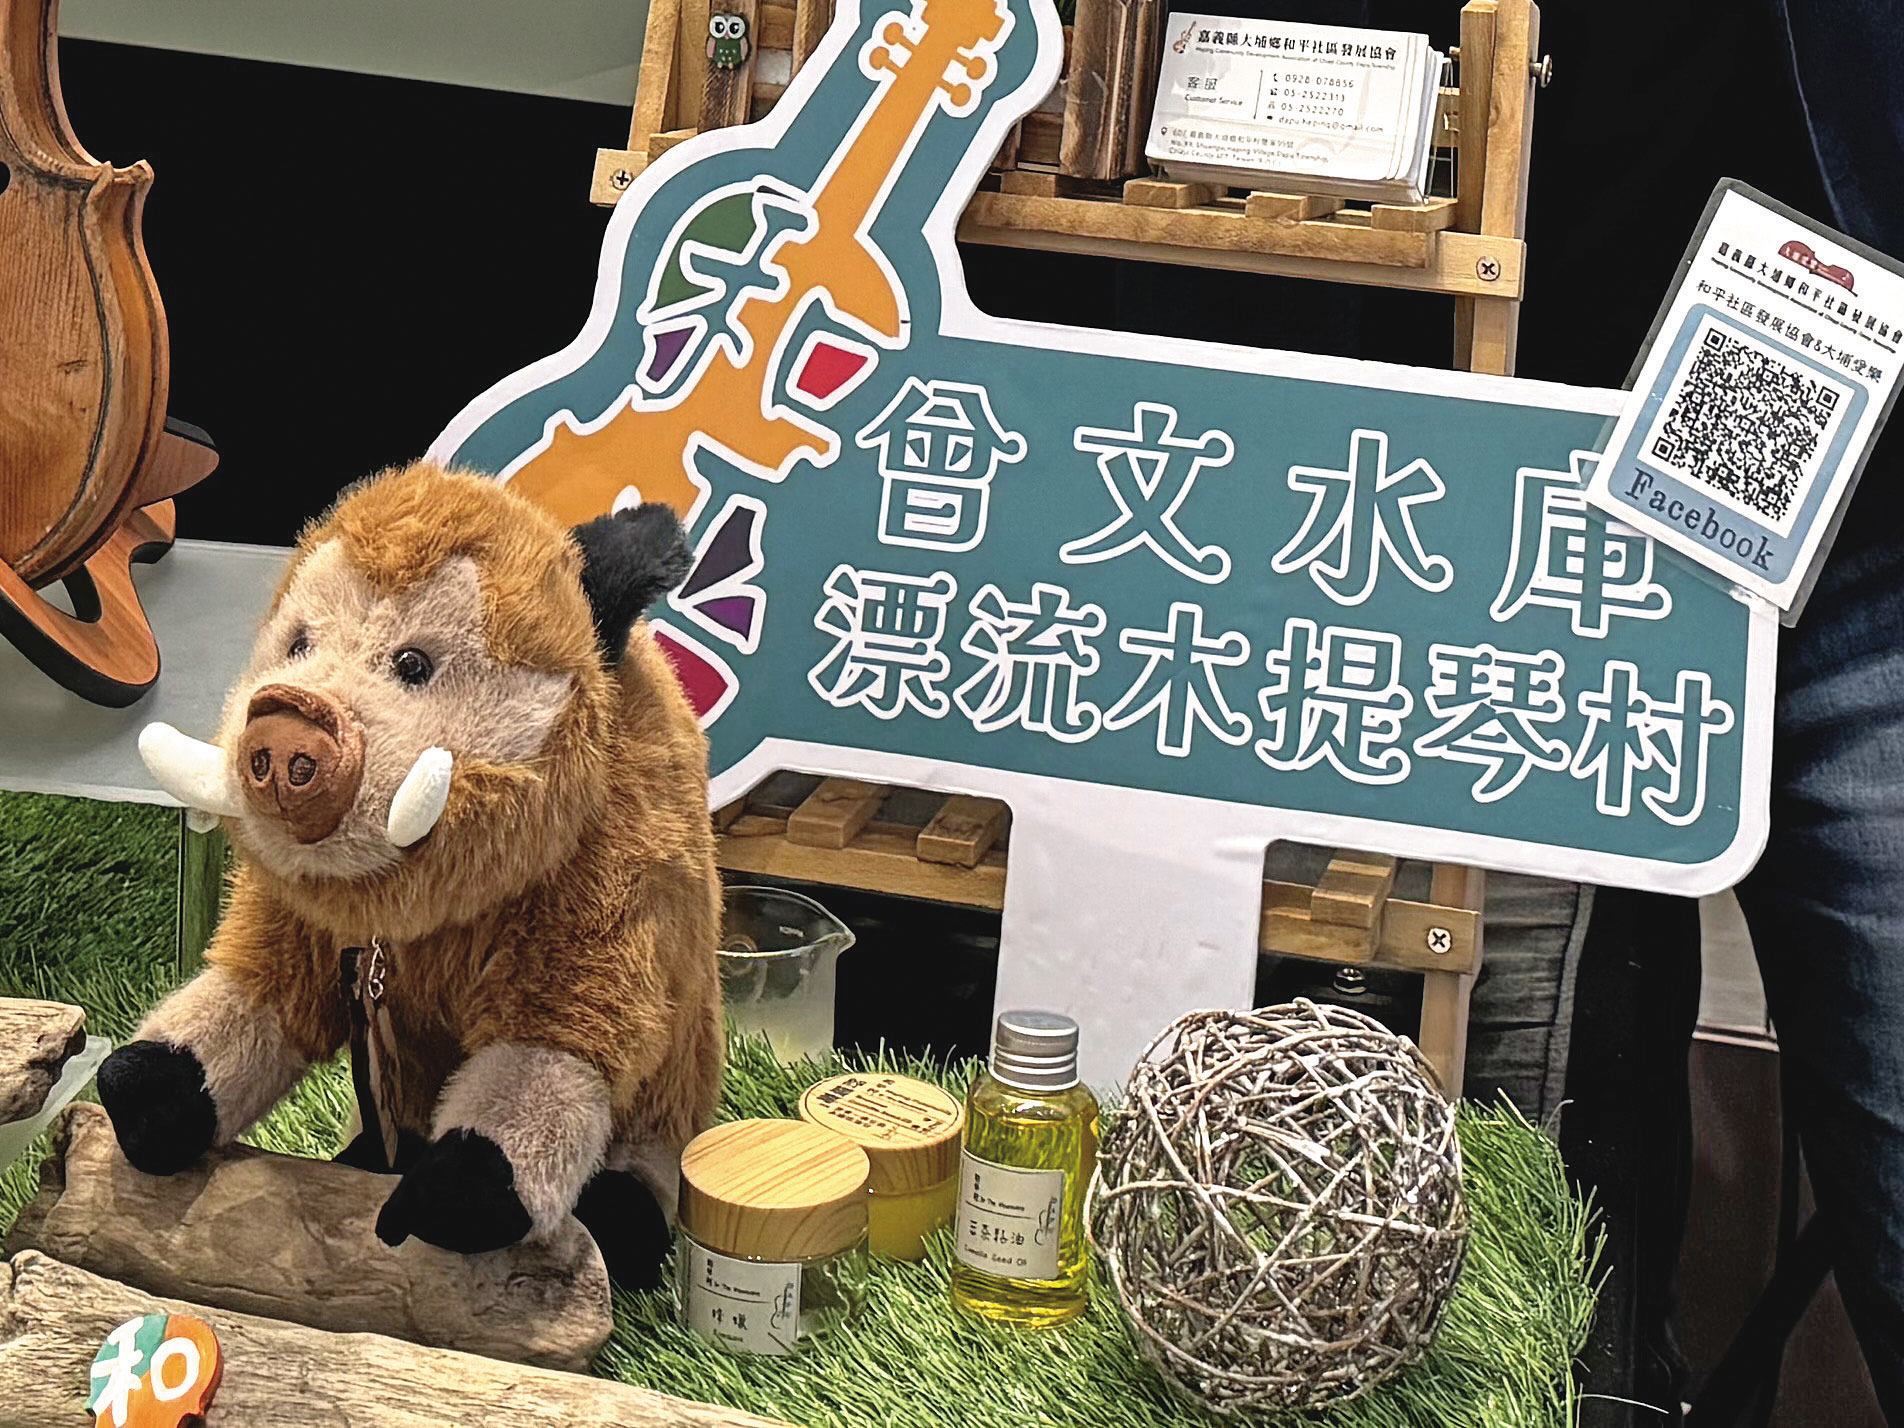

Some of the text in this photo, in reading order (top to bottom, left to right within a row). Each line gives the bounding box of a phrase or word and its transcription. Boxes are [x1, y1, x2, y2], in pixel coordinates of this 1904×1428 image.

[855, 376, 1673, 640] 曾文水庫
[1624, 468, 1775, 572] Facebook
[809, 565, 1735, 827] 漂流木提琴村
